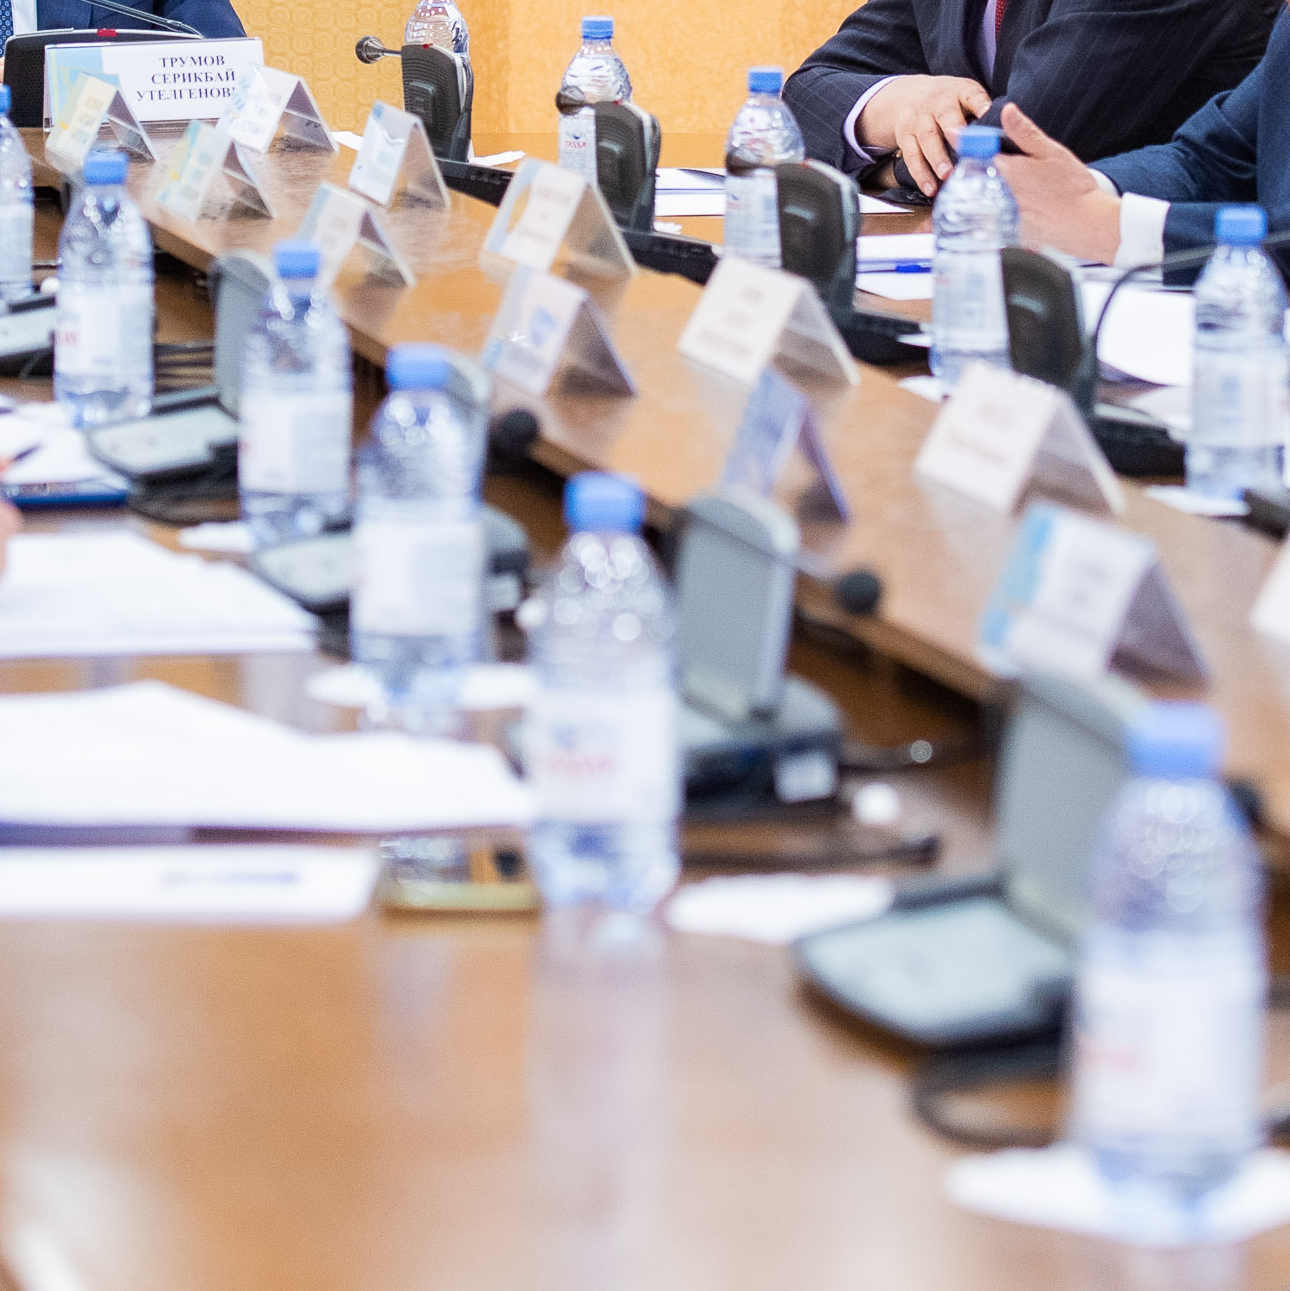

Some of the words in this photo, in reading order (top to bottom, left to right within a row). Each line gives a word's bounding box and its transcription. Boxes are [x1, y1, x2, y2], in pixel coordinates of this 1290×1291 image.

[159, 55, 225, 68] ТРУМОВ
[151, 68, 236, 85] СЕРИКБАЙ
[136, 87, 236, 102] УТЕЛГЕНОВ
